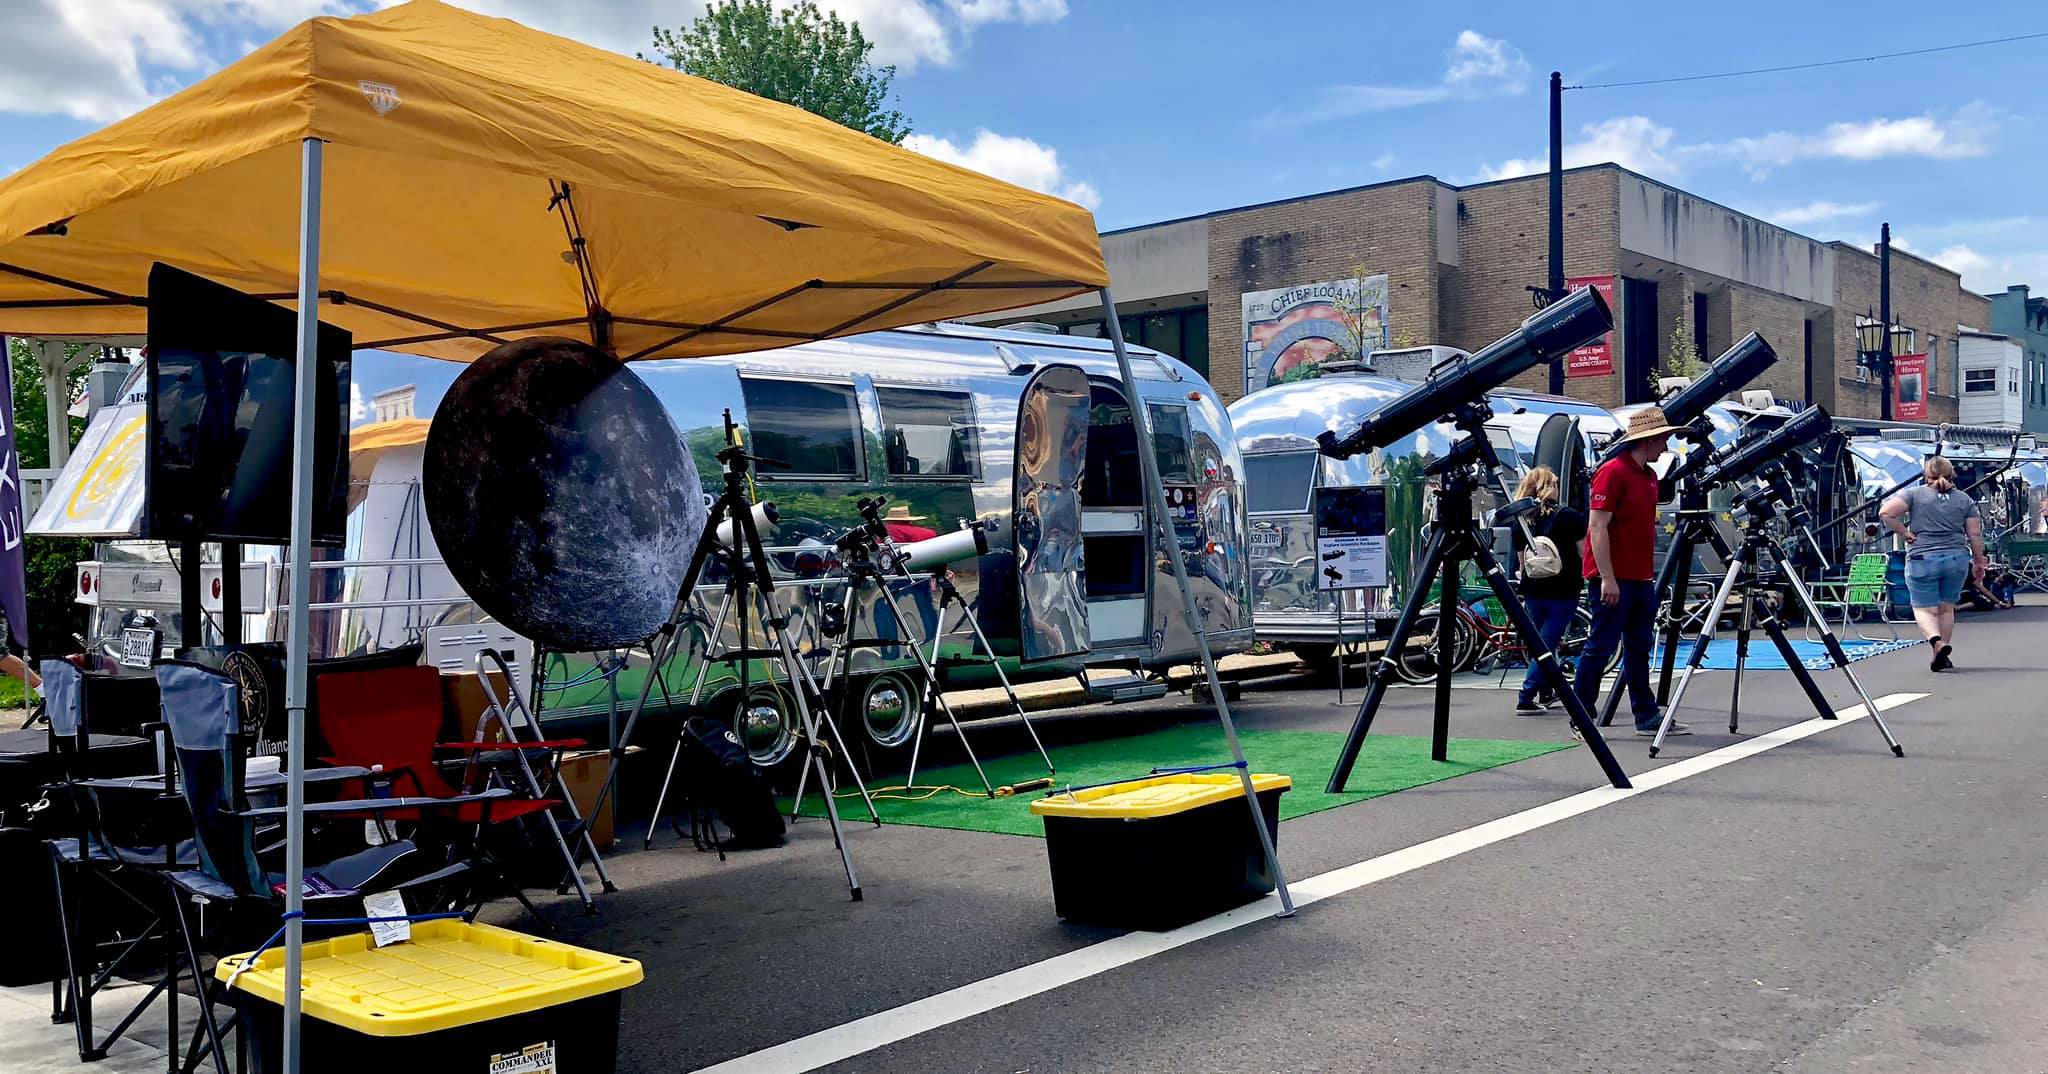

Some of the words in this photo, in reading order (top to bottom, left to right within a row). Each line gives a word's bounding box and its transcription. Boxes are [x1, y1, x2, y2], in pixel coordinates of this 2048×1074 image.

[1270, 287, 1310, 314] CHIEF
[492, 1049, 553, 1072] COMMANDER
[535, 1057, 553, 1069] XXL
